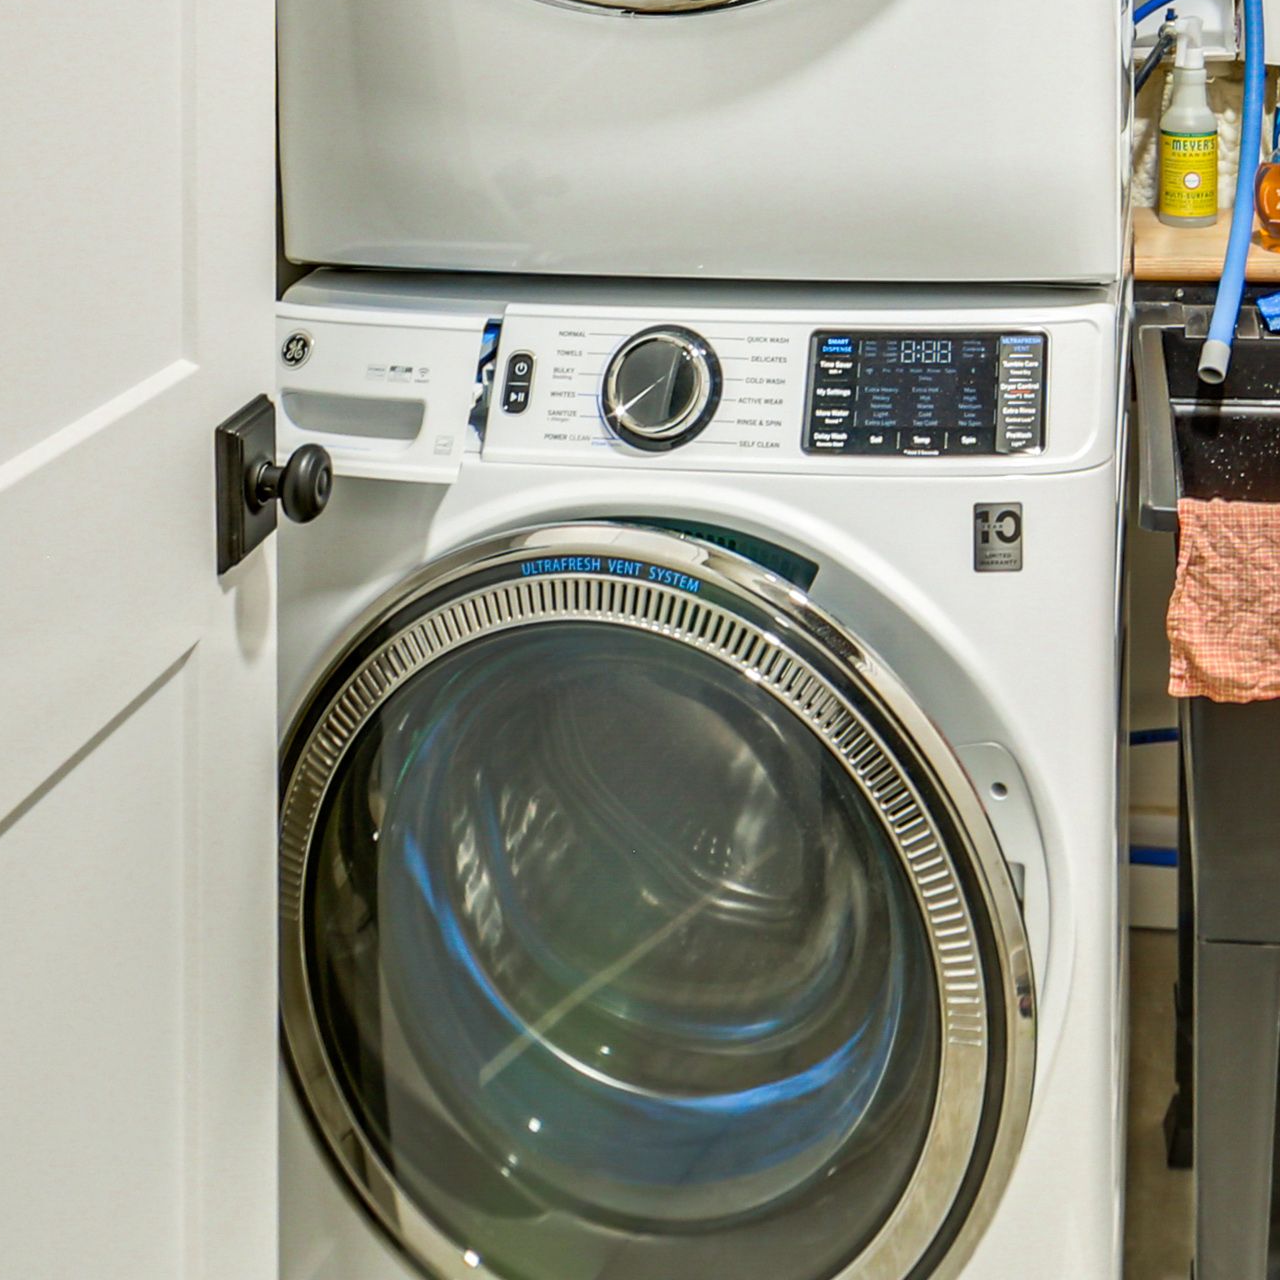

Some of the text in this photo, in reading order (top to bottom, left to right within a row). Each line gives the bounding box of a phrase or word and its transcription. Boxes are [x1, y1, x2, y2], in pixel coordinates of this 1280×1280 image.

[1172, 138, 1215, 152] MEYER'S
[816, 388, 851, 397] My Settings
[814, 432, 848, 441] Delay Wash
[869, 435, 883, 444] Soil
[913, 435, 931, 445] Temp
[961, 435, 977, 445] Spin
[975, 510, 1021, 544] 10
[521, 557, 701, 592] ULTRAFRESH VENT SYSTEM
